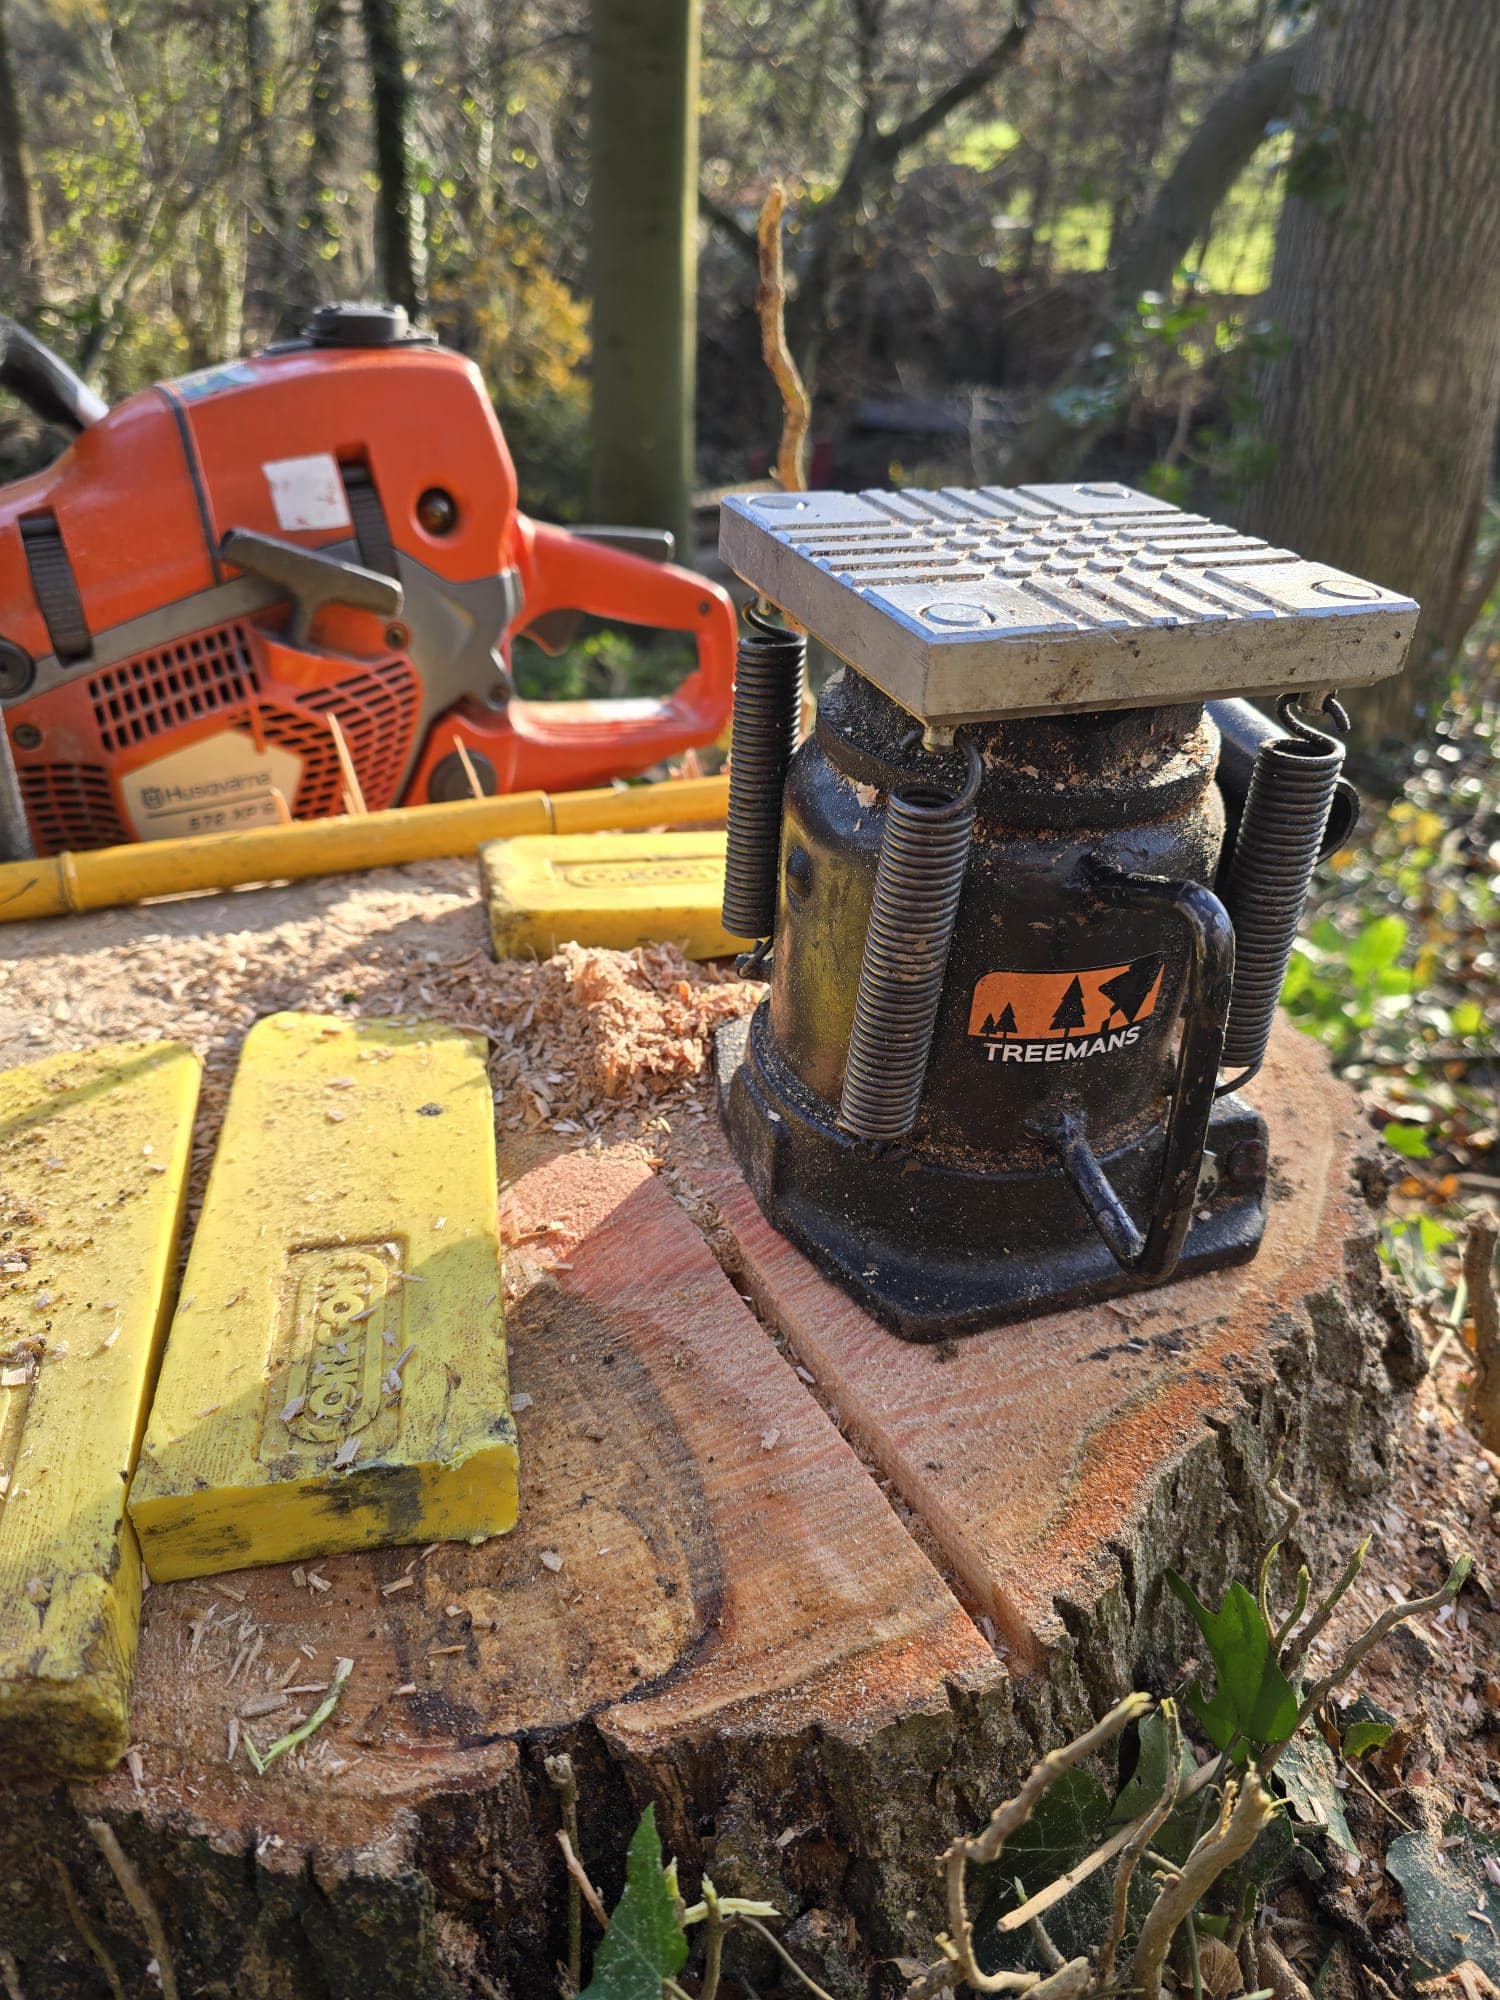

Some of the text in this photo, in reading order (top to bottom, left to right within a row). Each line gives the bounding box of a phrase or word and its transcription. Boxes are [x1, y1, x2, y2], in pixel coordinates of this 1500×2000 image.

[165, 772, 271, 800] Husqvarna
[984, 1026, 1142, 1063] TREEMANS
[309, 1270, 369, 1417] OREGON
